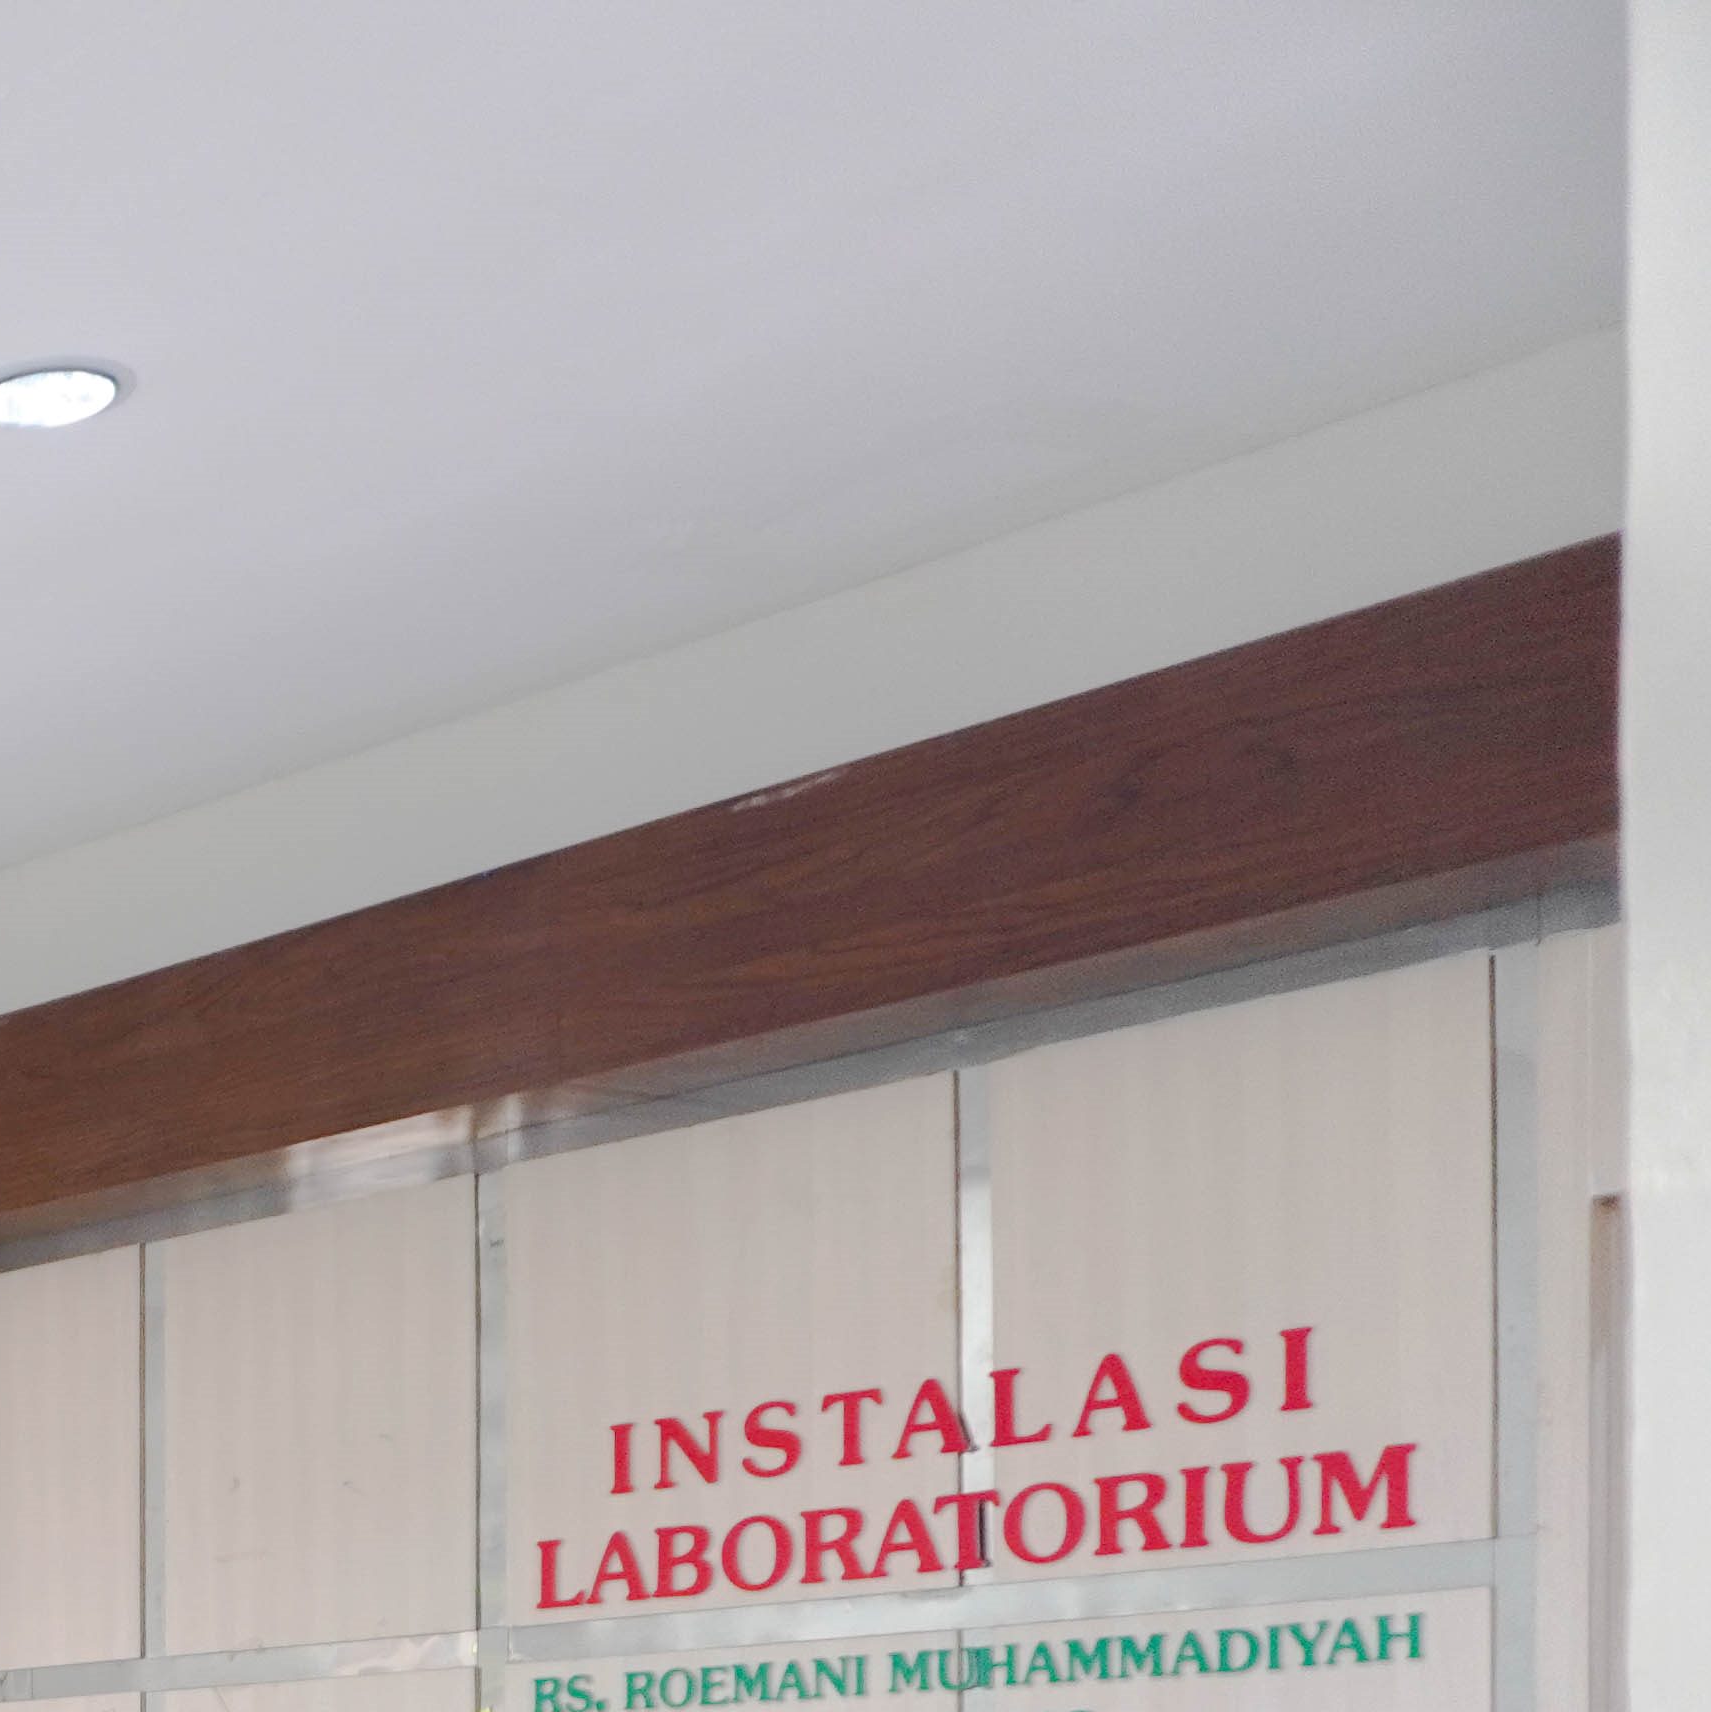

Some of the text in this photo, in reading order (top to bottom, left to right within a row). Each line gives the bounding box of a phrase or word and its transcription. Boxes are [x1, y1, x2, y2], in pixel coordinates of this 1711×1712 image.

[609, 1327, 1313, 1494] INSTALASI
[537, 1443, 1416, 1609] LABORATORIUM
[624, 1655, 867, 1710] ROEMANI
[888, 1613, 1424, 1693] MUHAMMADIYAH
